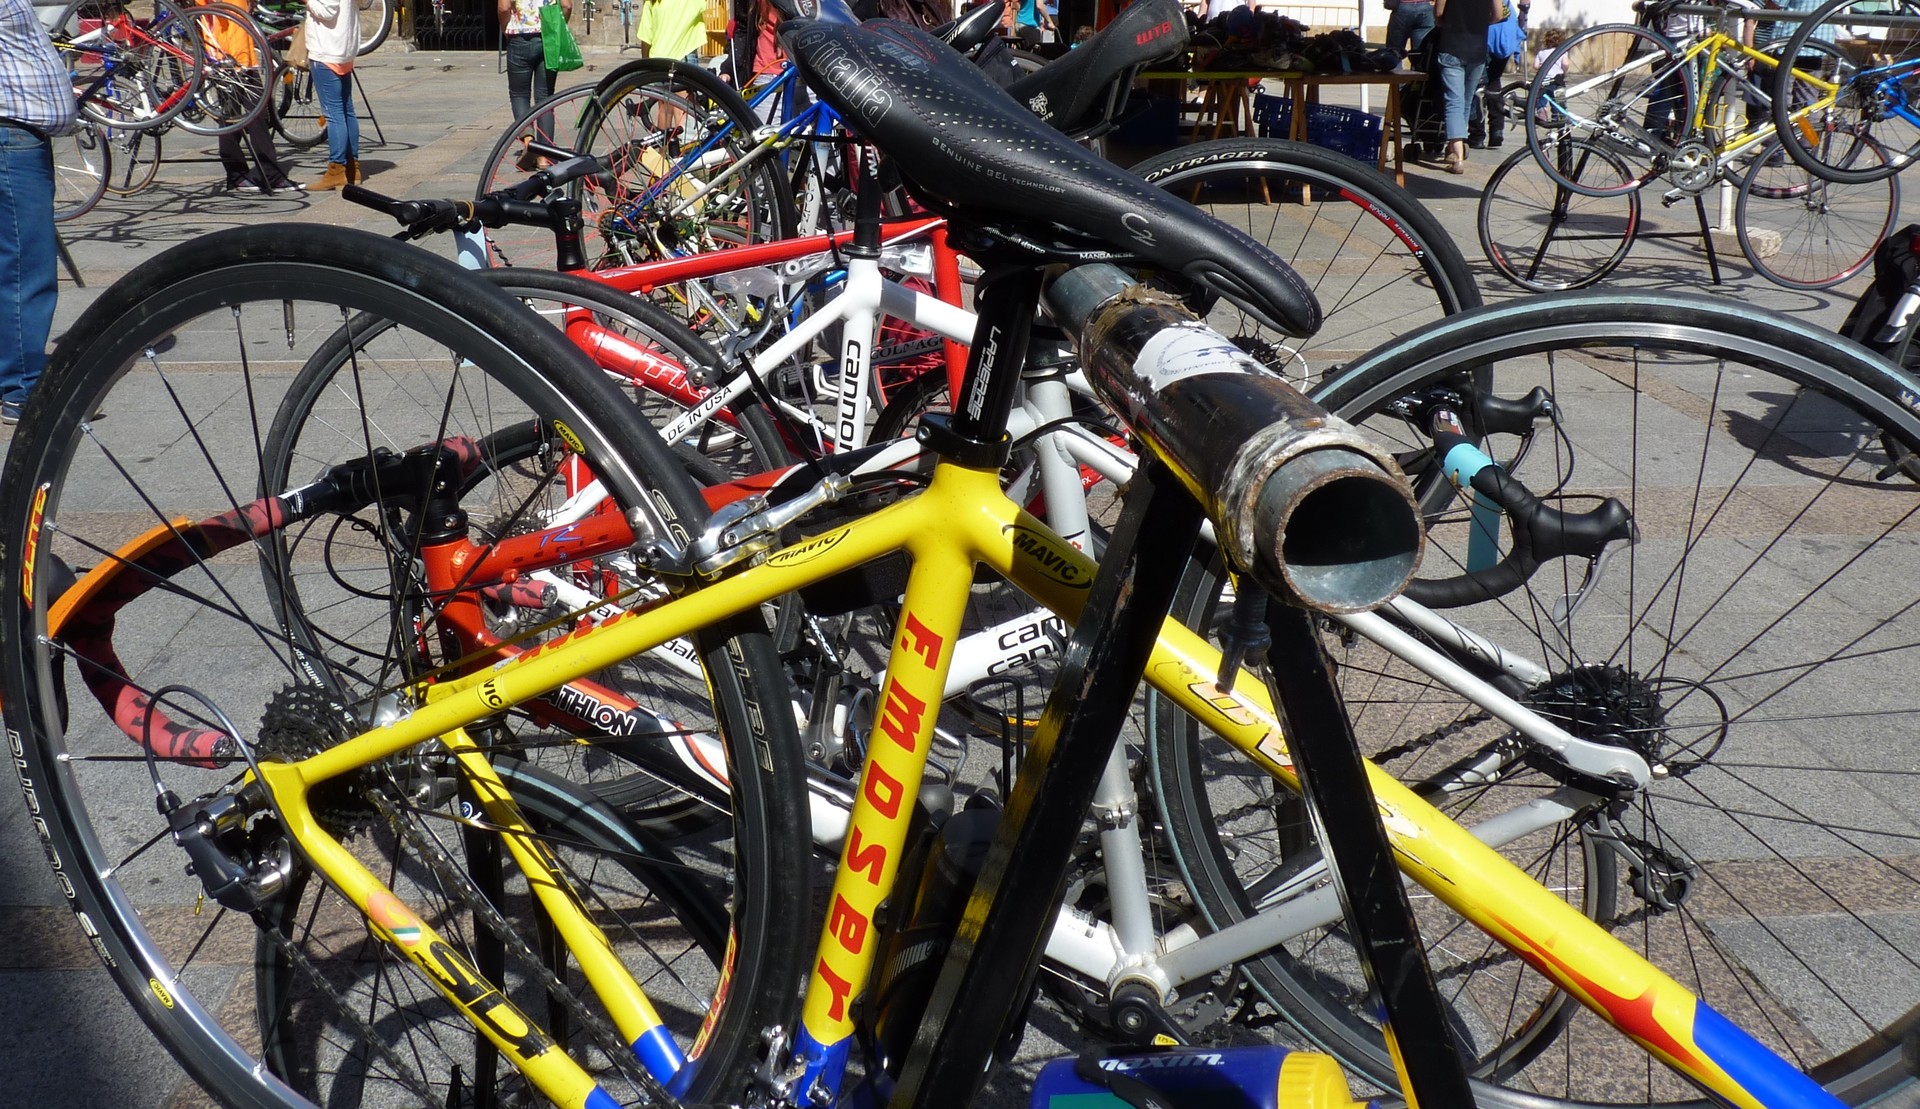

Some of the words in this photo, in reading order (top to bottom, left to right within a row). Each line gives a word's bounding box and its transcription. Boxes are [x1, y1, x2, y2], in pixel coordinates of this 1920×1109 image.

[1135, 21, 1172, 46] WTB
[808, 39, 892, 128] italia
[932, 136, 983, 173] GENUINE
[986, 168, 1008, 182] GEL
[1011, 177, 1067, 194] TECHNOLOGY
[1079, 250, 1136, 260] MANGANESE
[972, 325, 1002, 421] LAPIERRE
[667, 420, 687, 441] DE
[688, 408, 703, 425] IN
[705, 386, 733, 411] USA
[557, 425, 580, 450] MAVIC
[23, 487, 47, 604] ELITE
[780, 533, 838, 562] MAVIC
[1013, 533, 1079, 580] MAVIC
[484, 679, 503, 708] VIC
[548, 683, 638, 737] ATHLON
[152, 982, 171, 1004] MAVIC
